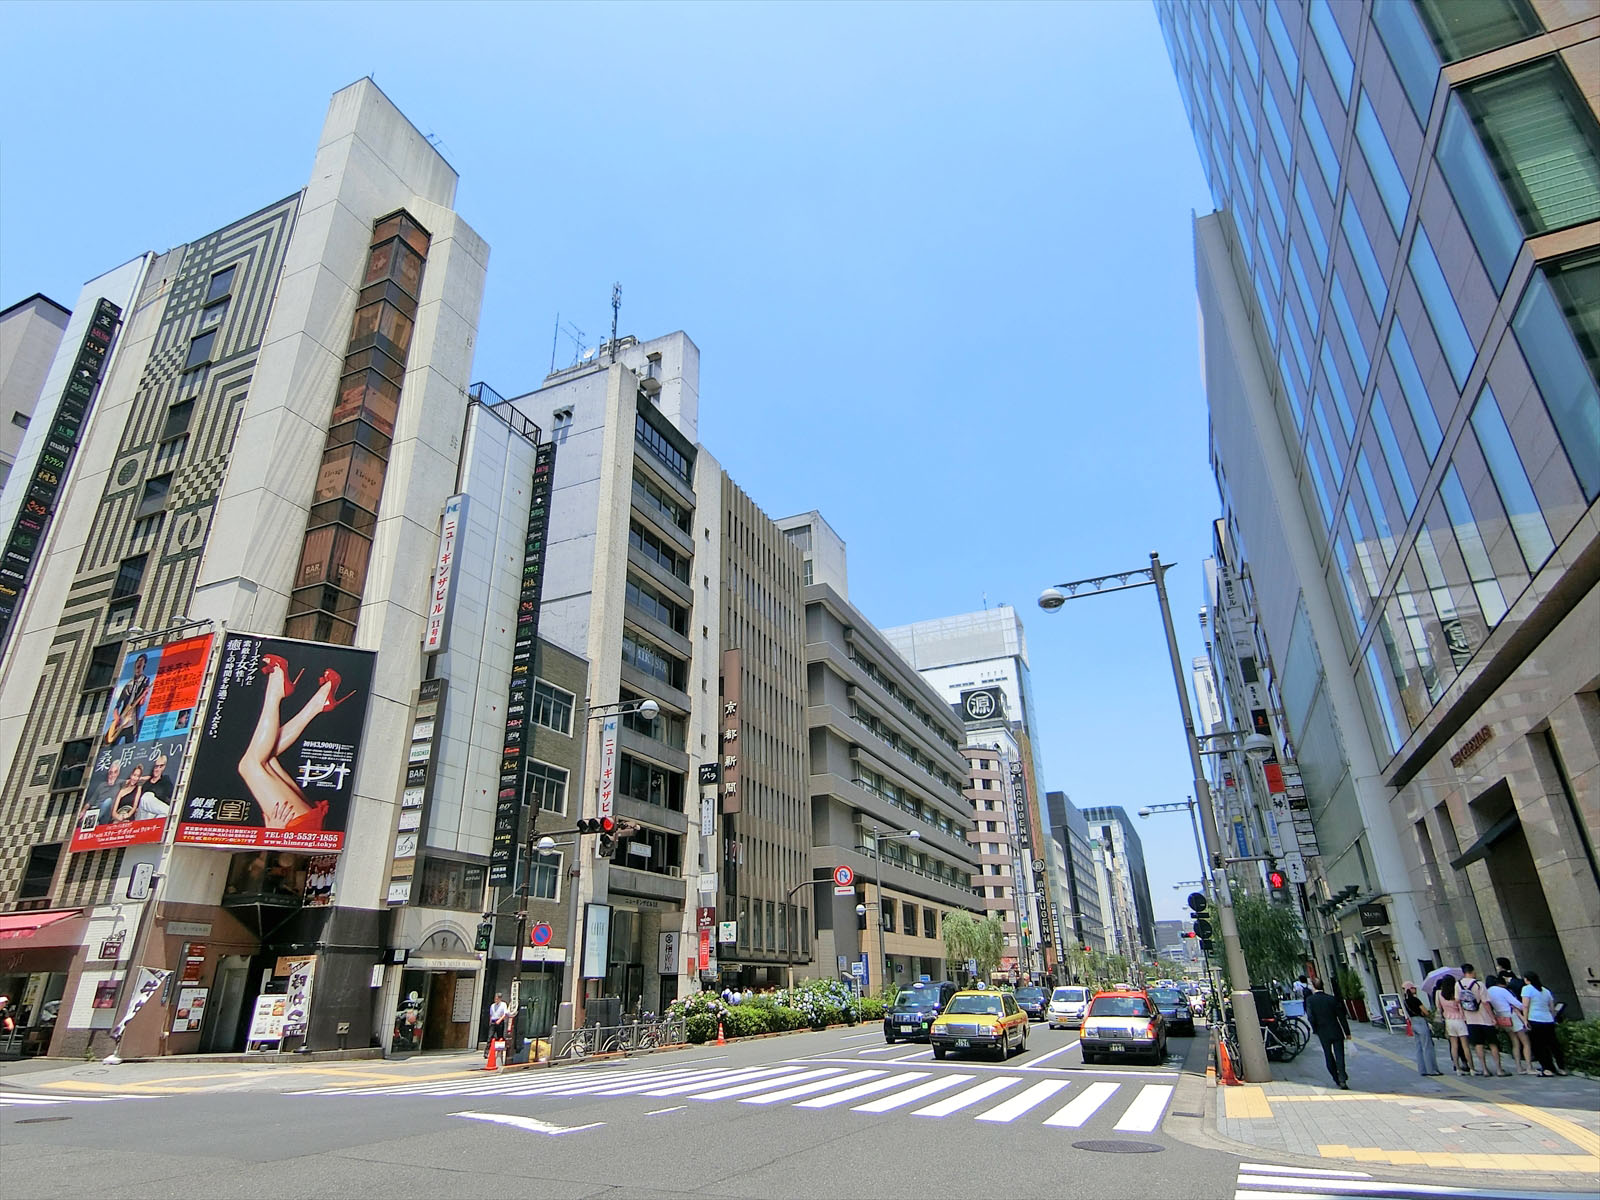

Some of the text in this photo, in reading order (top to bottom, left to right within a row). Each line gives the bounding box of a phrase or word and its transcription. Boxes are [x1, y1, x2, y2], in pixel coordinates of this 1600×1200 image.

[7, 551, 30, 563] REINA
[1, 568, 25, 580] REINA
[432, 521, 455, 615] ニューギンザビル
[245, 641, 262, 686] リーズナブルに
[970, 696, 990, 714] 源
[724, 701, 738, 795] 京都新聞
[95, 742, 183, 772] 桑原あい
[408, 768, 425, 778] BAR.
[190, 797, 217, 809] 銀座
[189, 808, 217, 820] 熟女
